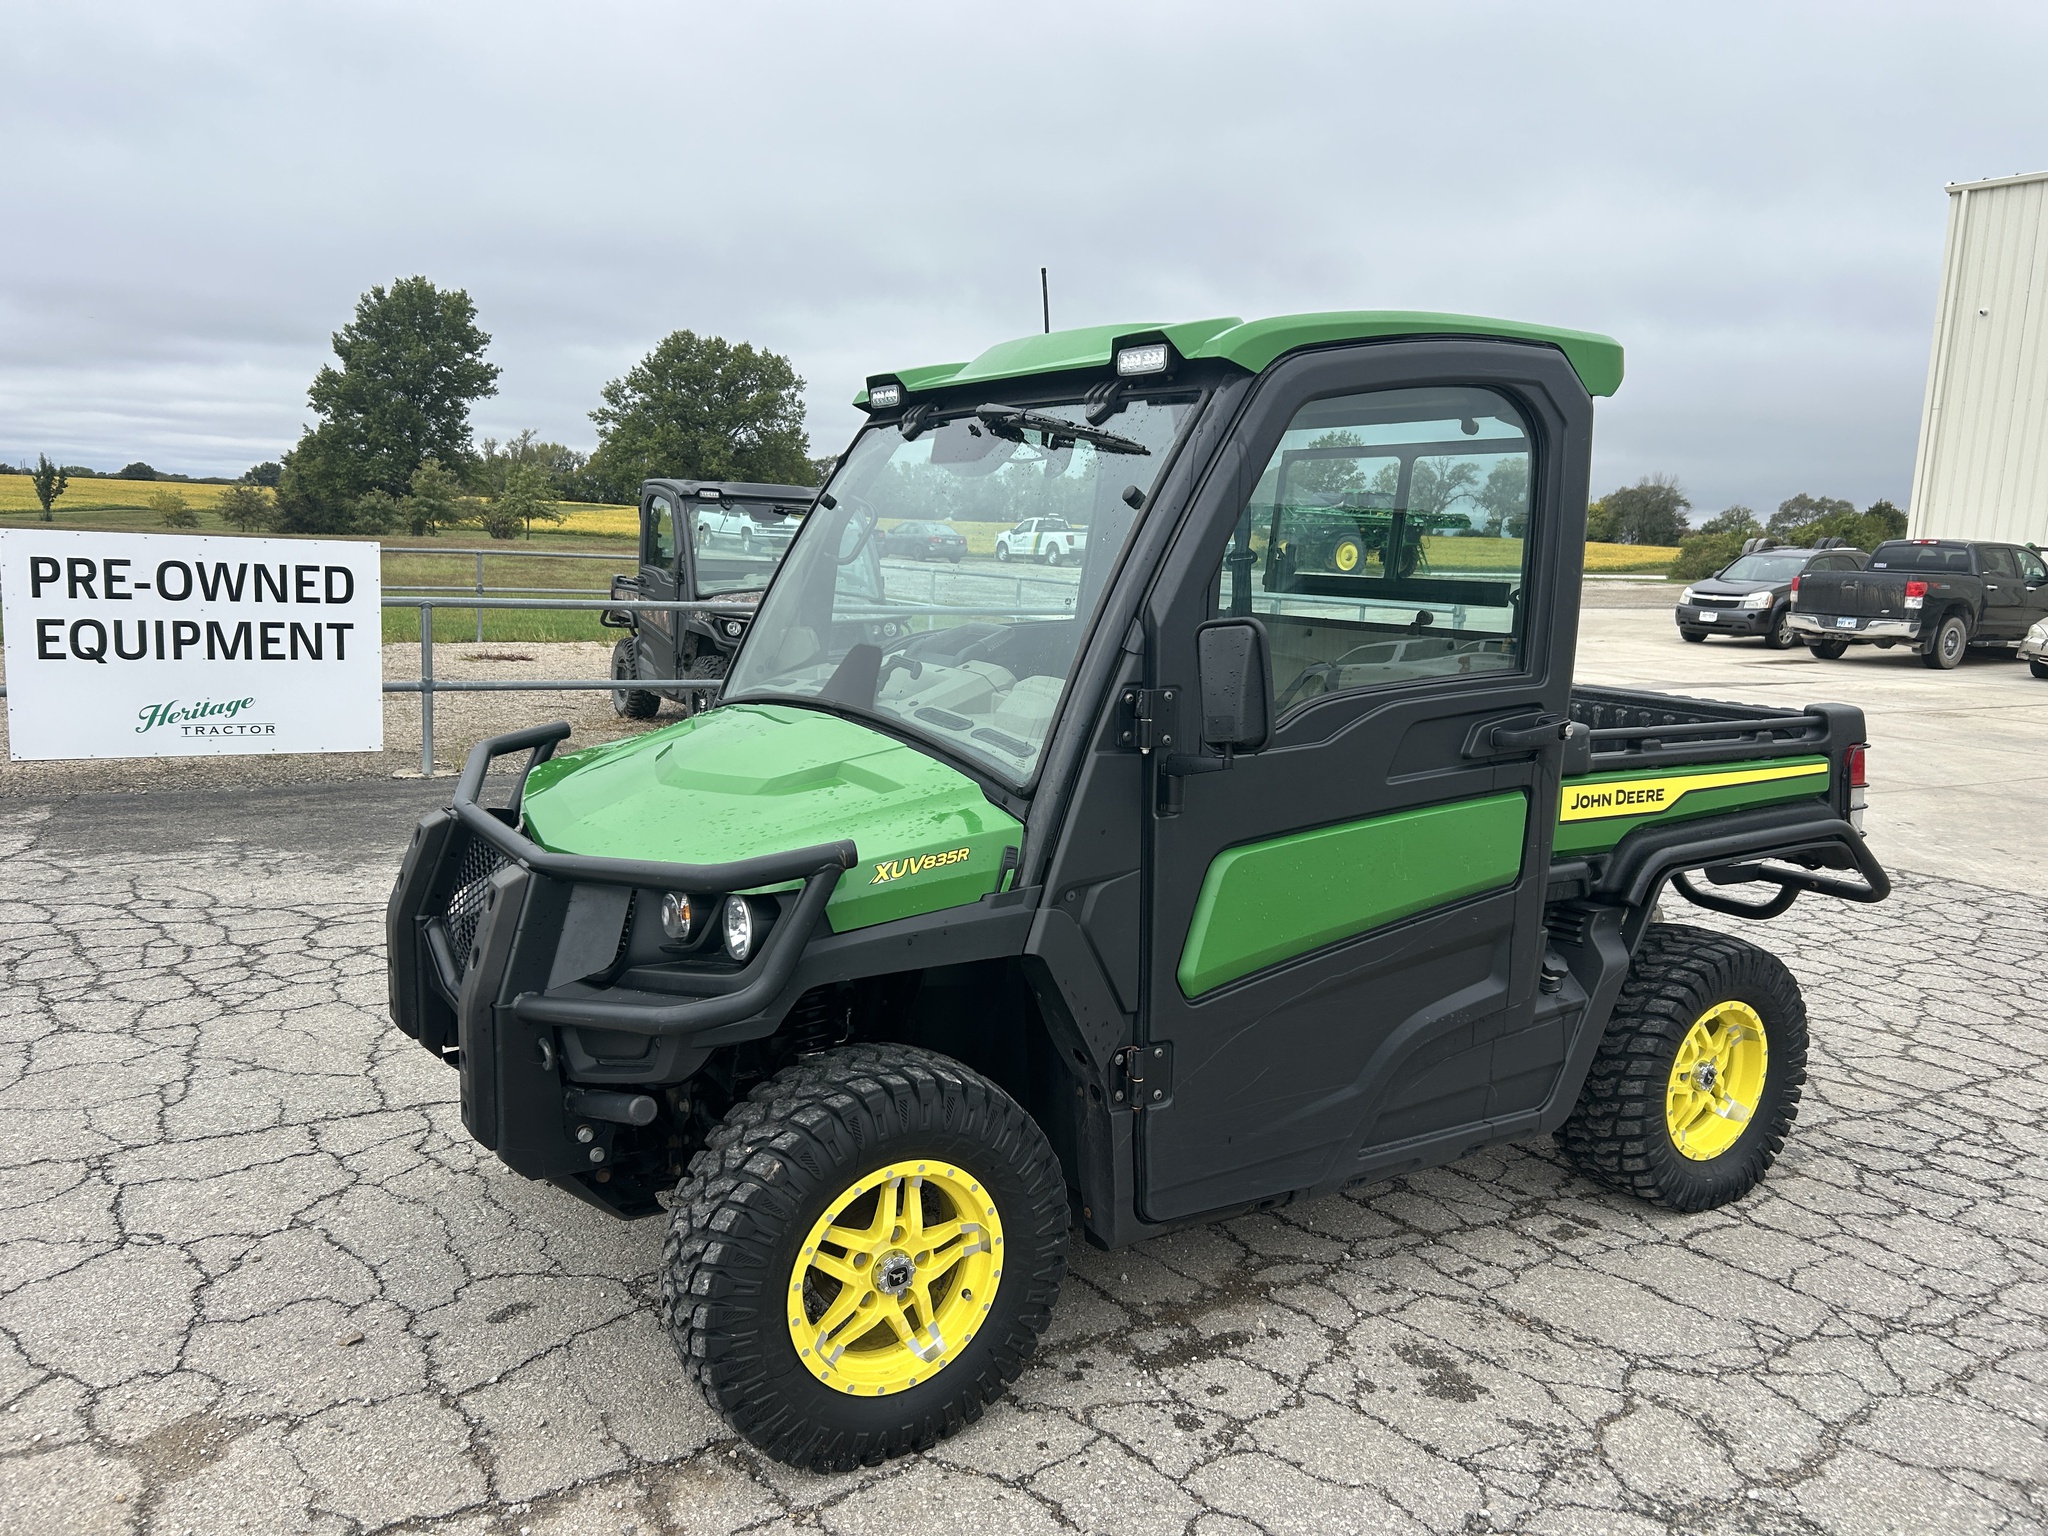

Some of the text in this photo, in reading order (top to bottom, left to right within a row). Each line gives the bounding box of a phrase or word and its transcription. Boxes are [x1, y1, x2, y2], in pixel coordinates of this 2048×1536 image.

[29, 556, 355, 604] PRE-OWNED
[36, 618, 354, 664] EQUIPMENT
[135, 696, 256, 734] Heritage
[181, 725, 276, 736] TRACTOR
[1570, 788, 1665, 810] JOHN DEERE
[869, 847, 971, 885] XUV835R
